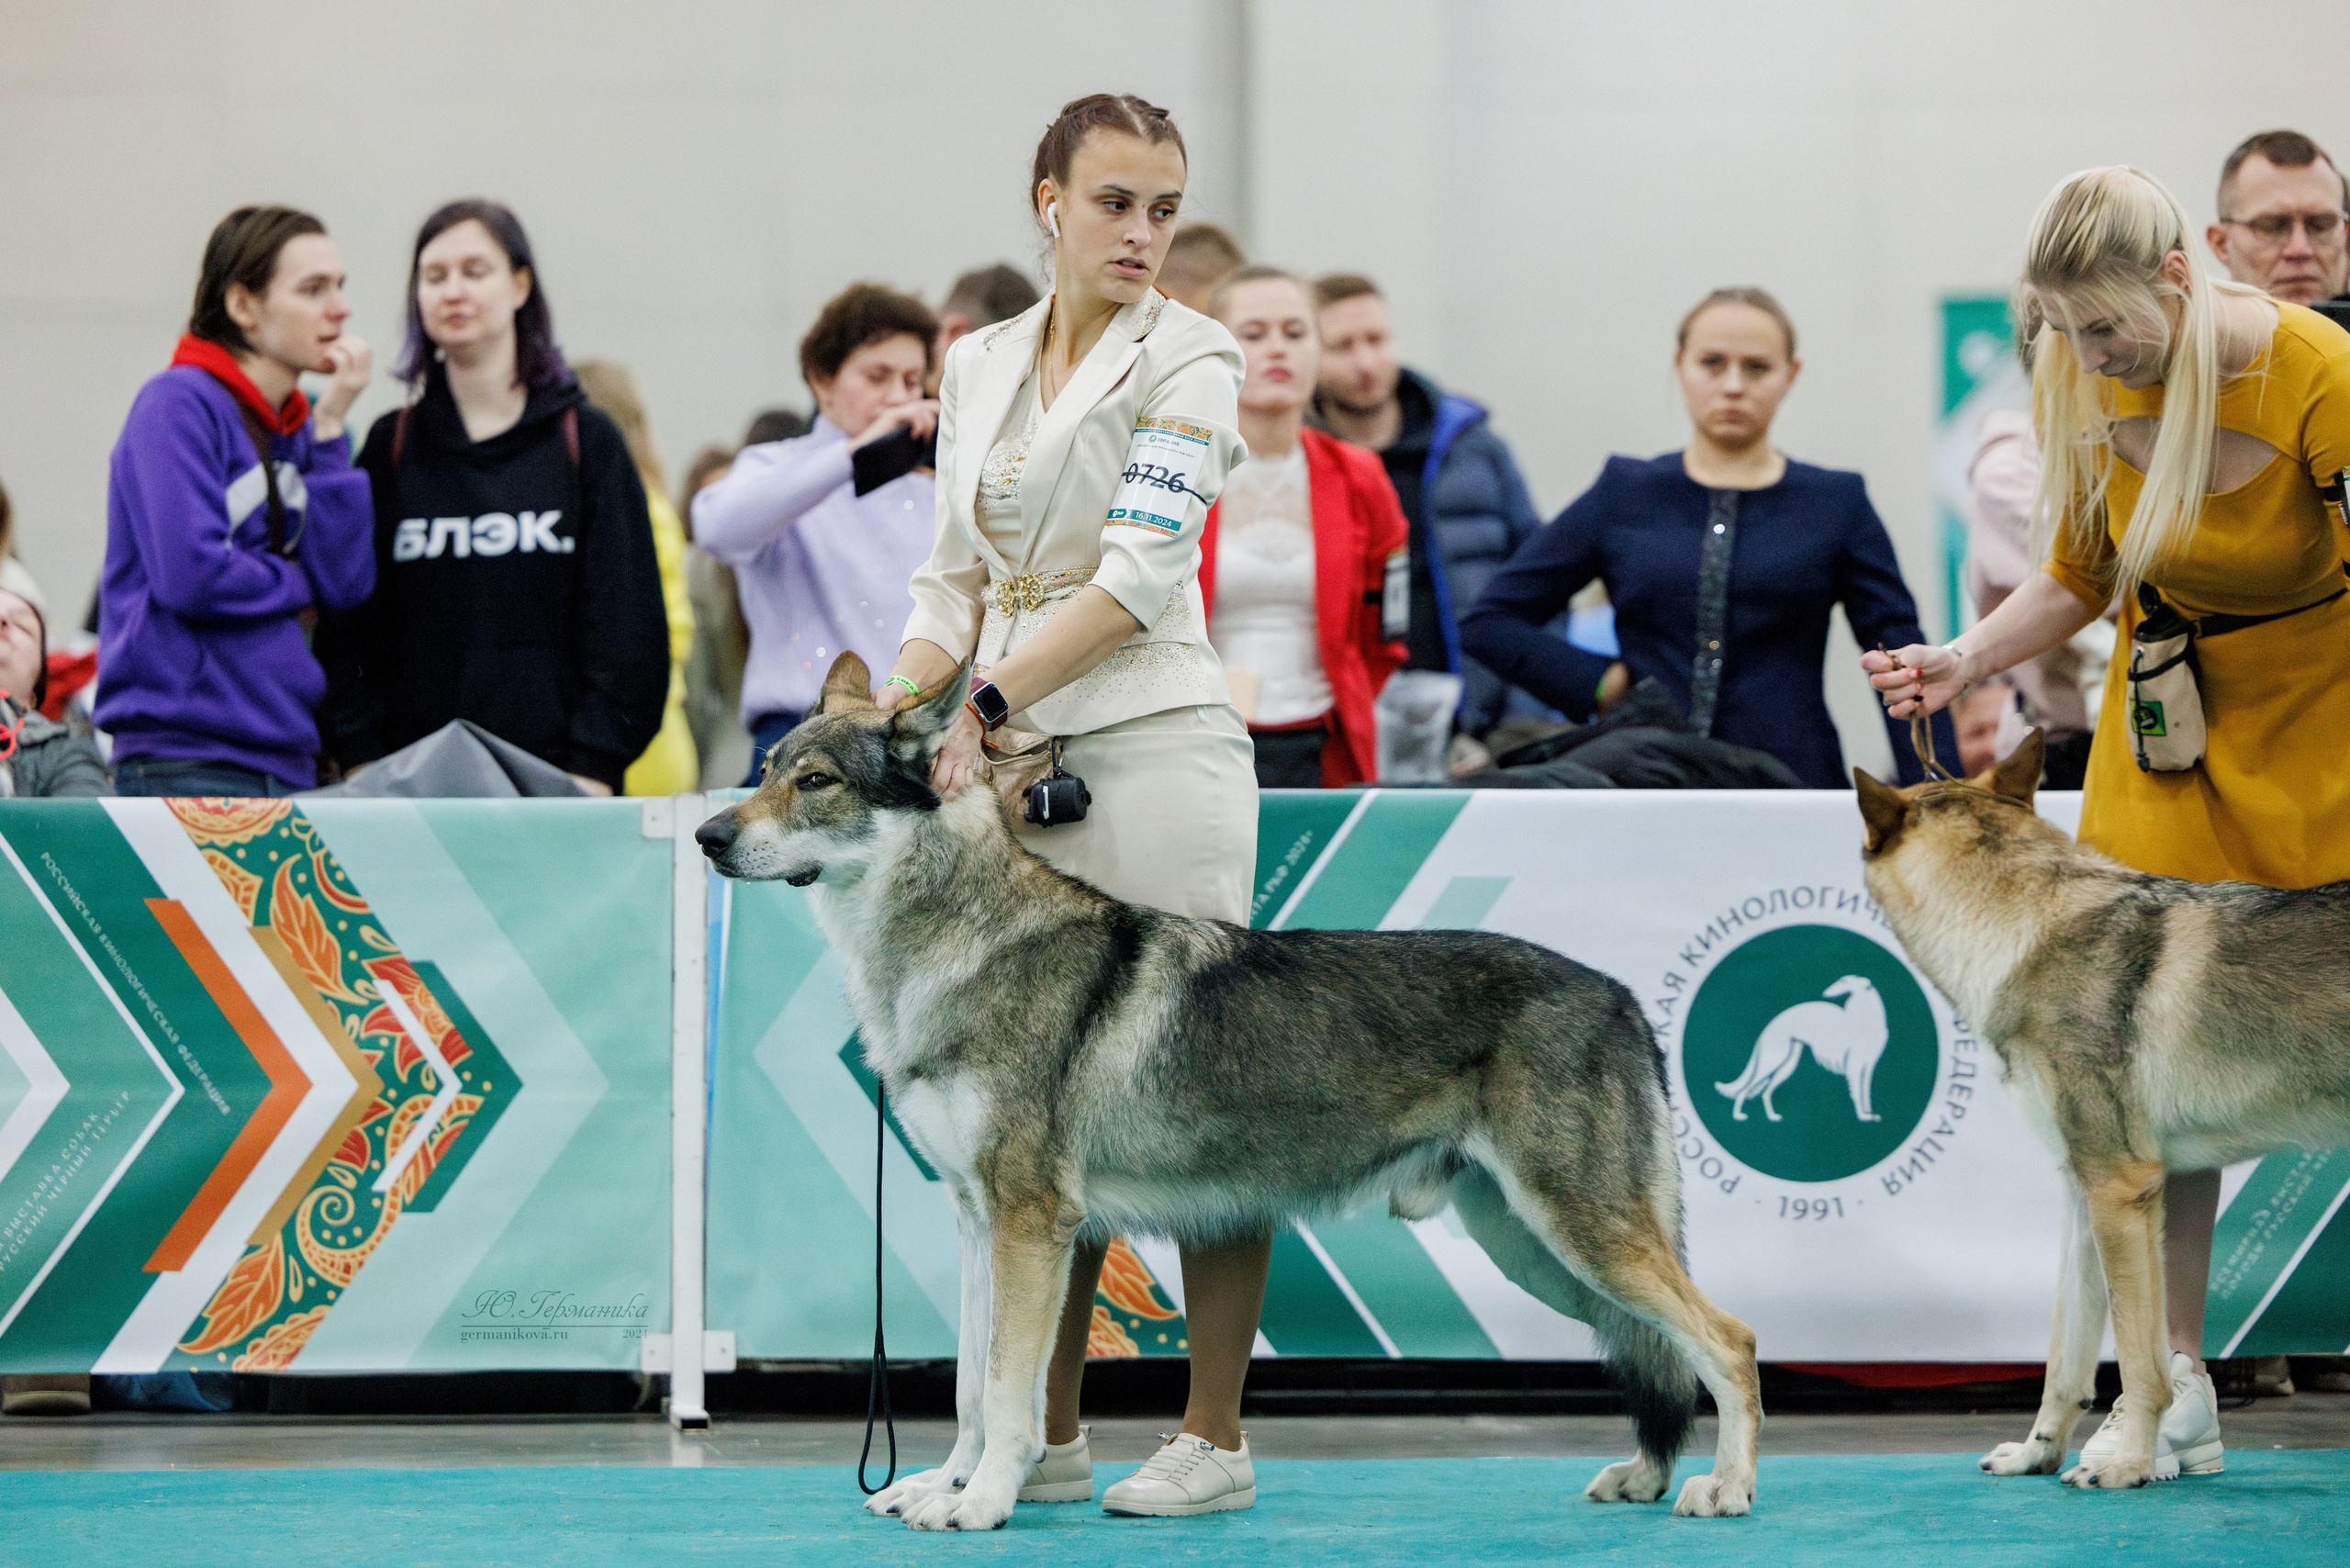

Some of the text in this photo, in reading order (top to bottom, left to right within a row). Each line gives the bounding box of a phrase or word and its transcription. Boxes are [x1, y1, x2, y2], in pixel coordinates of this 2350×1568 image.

[1125, 462, 1186, 493] 0726
[393, 510, 576, 562] БЛЭК.
[1136, 511, 1172, 527] 16.11.2024
[40, 851, 230, 1116] РОССИЙСКАЯ КИНОЛОГИЧЕСКАЯ ФЕДЕРАЦИЯ
[1653, 971, 1740, 1194] РОССКАЯ
[4, 1113, 99, 1238] ВЫСТАВКА СОБАК
[1779, 1196, 1844, 1221] 1991
